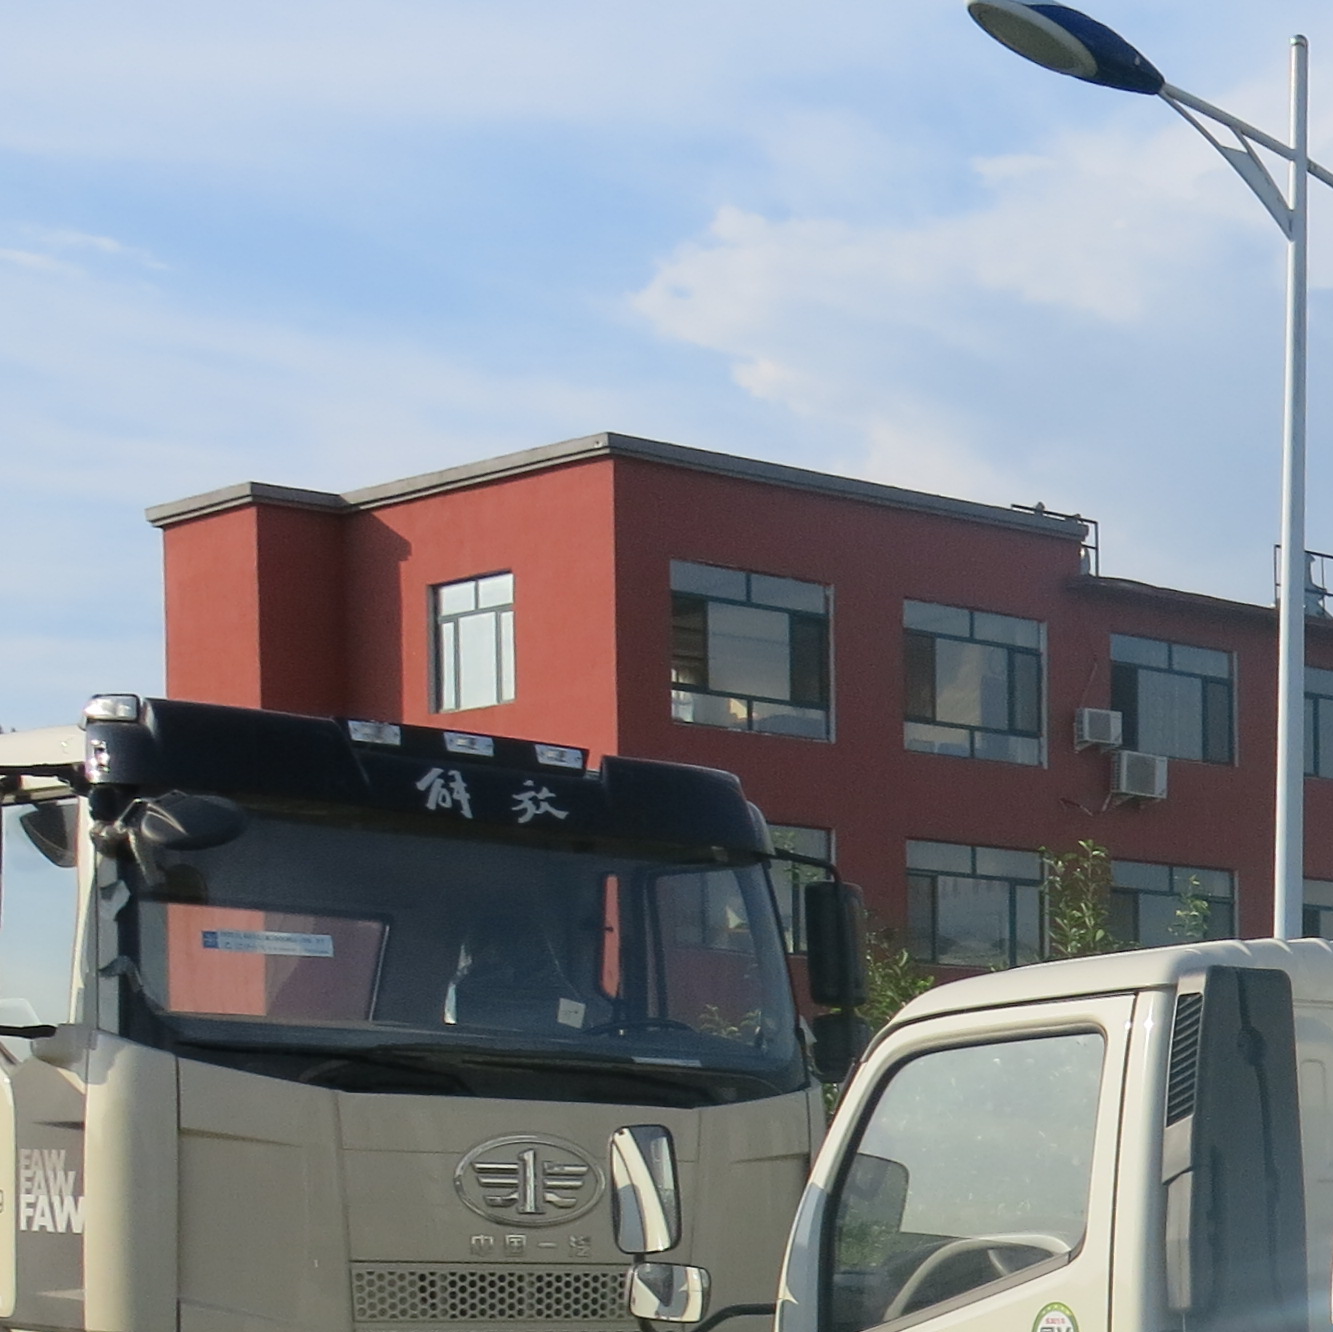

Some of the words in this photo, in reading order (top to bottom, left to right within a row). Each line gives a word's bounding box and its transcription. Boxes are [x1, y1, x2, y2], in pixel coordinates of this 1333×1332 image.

[416, 767, 569, 824] 解放
[20, 1194, 85, 1233] FAW
[471, 1234, 591, 1257] 中国一汽
